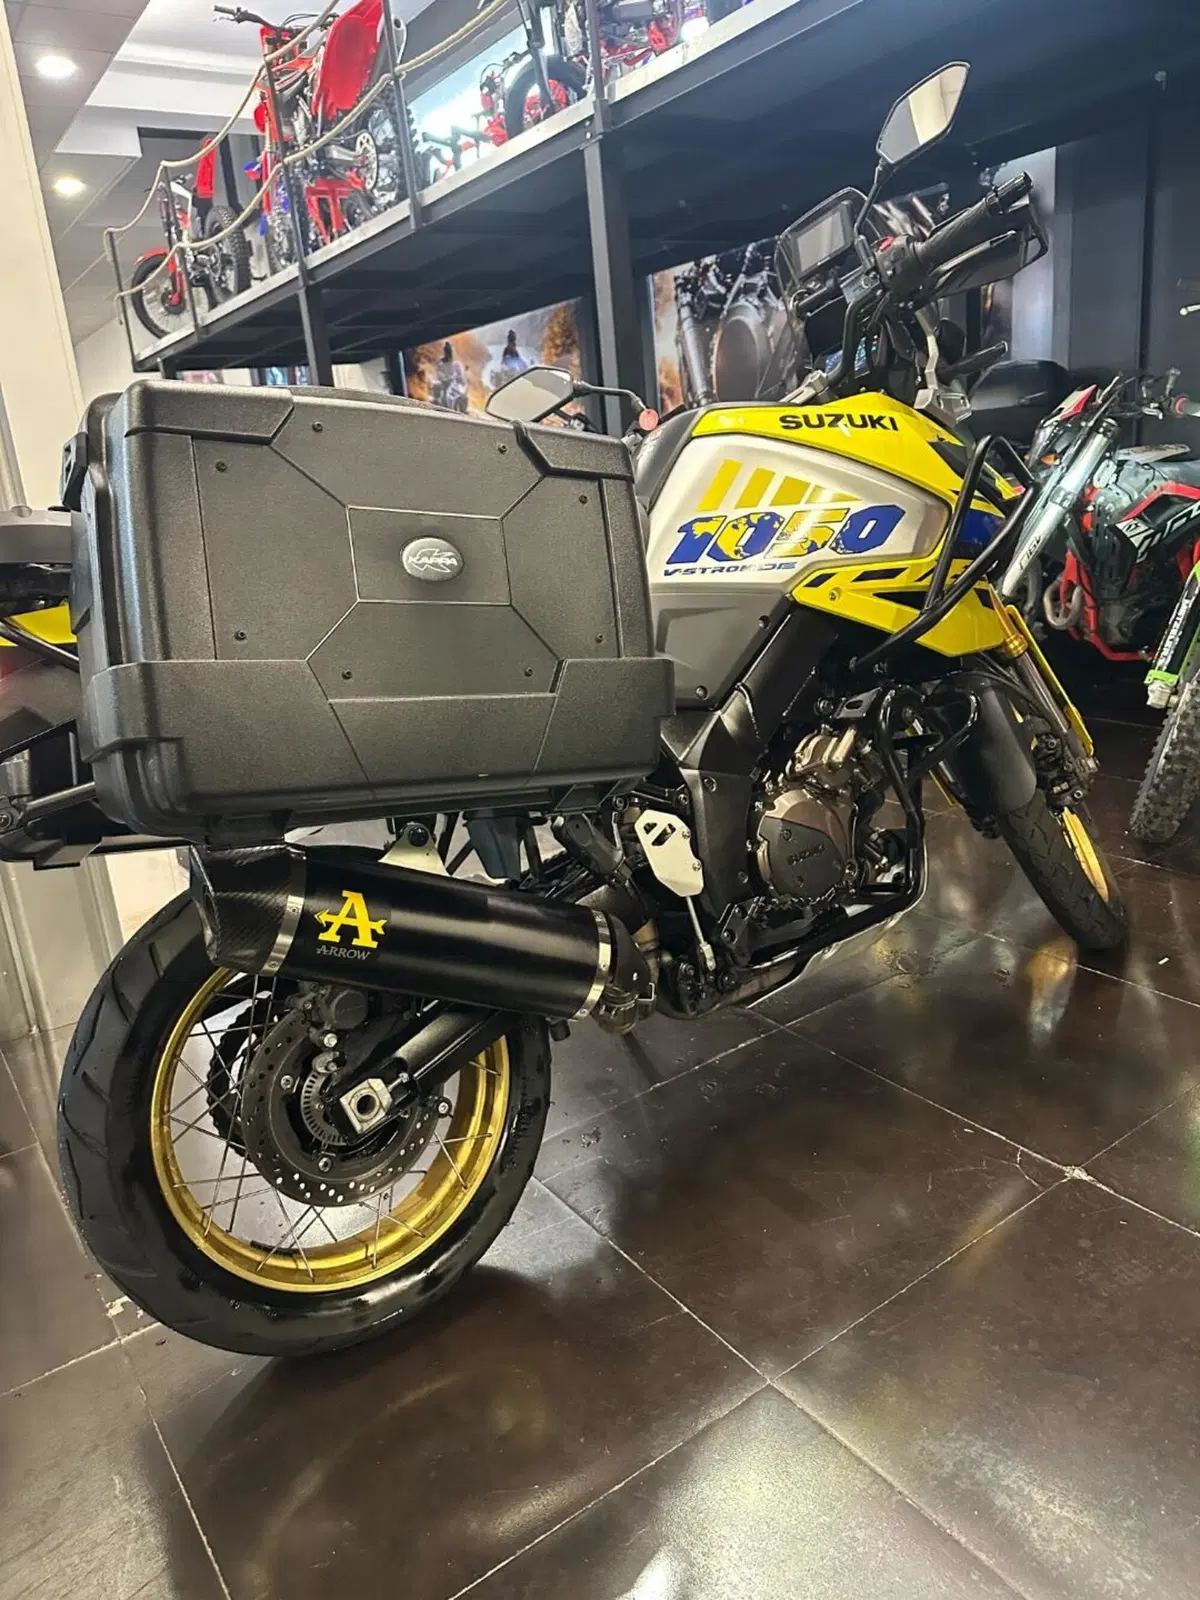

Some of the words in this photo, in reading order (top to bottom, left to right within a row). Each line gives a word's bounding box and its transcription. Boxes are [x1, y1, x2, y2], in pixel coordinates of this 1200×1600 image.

[779, 413, 899, 431] SUZUKI
[666, 504, 906, 564] 1050
[316, 944, 371, 960] ARROW
